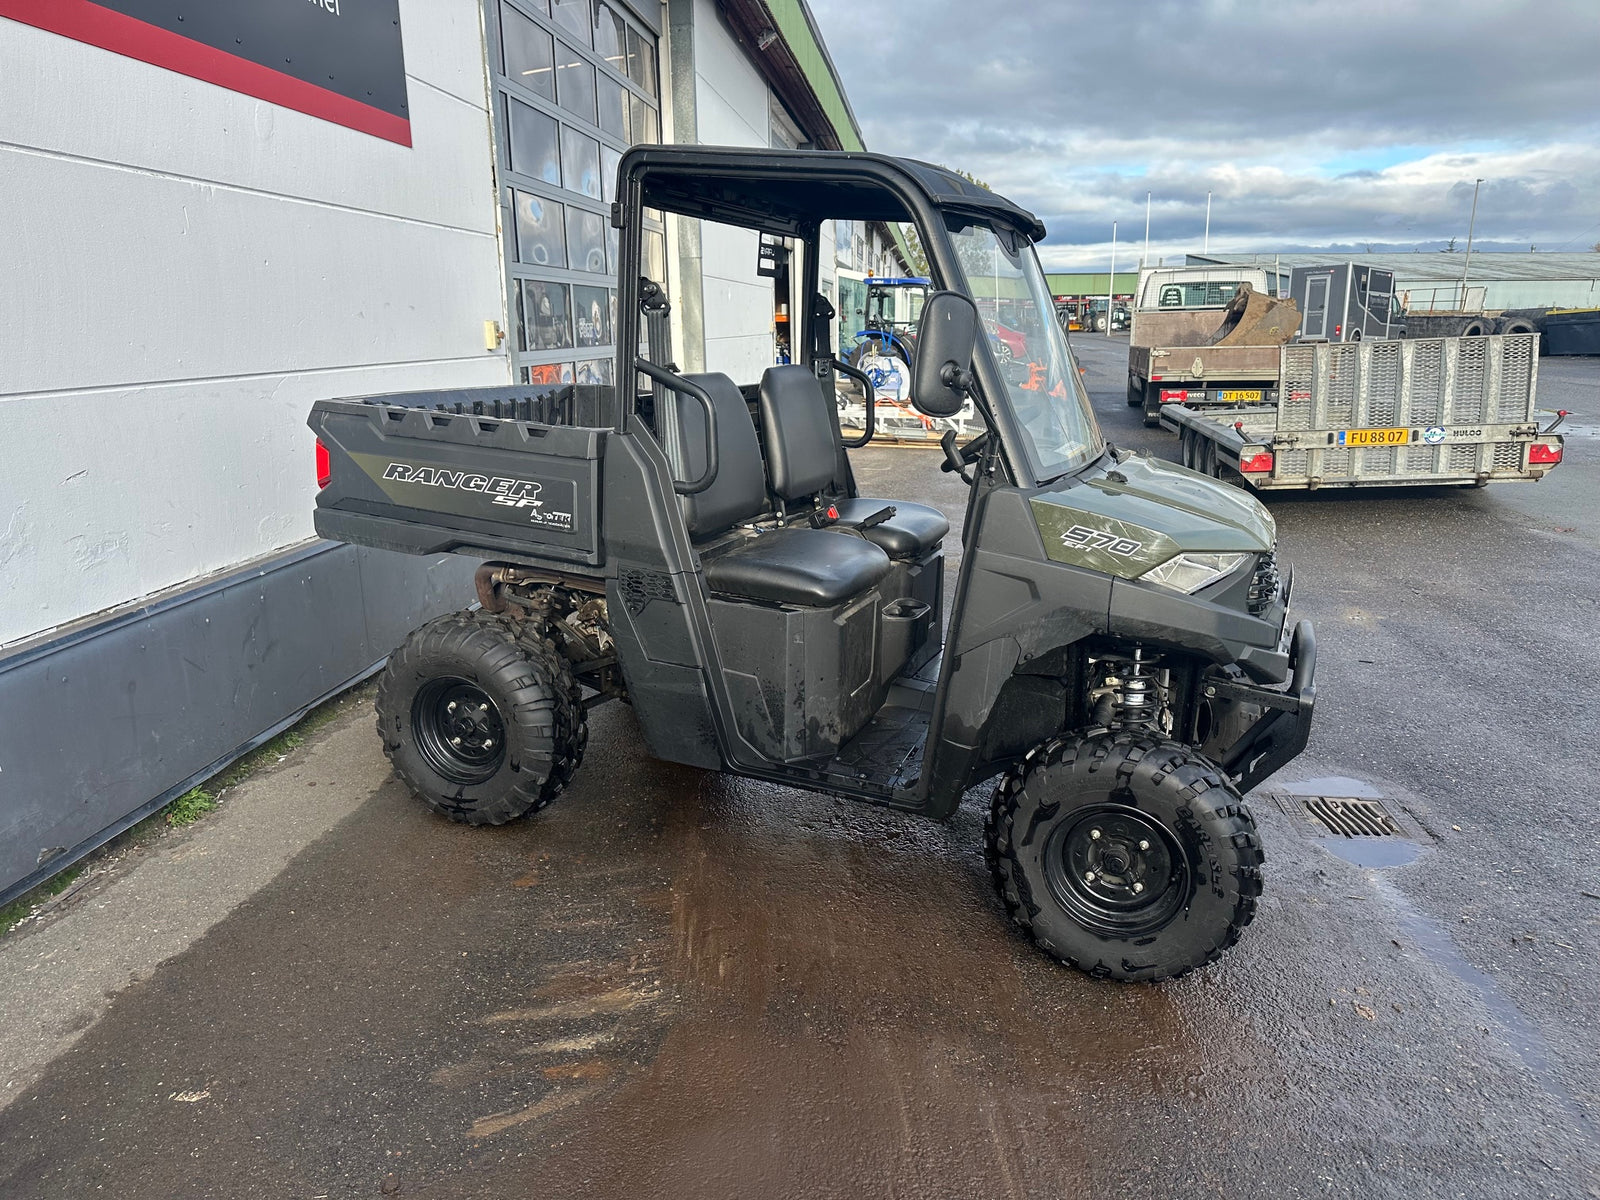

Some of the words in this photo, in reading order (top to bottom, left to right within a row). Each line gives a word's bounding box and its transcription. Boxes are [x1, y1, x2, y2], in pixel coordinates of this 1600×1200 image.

[1223, 392, 1232, 400] DT
[1235, 391, 1244, 400] 16
[1245, 391, 1260, 399] 507
[1351, 432, 1367, 443] FU
[1370, 431, 1385, 443] 88
[1388, 431, 1403, 442] 07
[383, 463, 542, 499] RANGER
[492, 495, 543, 507] SP
[1061, 524, 1142, 557] 570
[1063, 541, 1092, 552] EFI
[1175, 805, 1225, 899] CARLISLE
